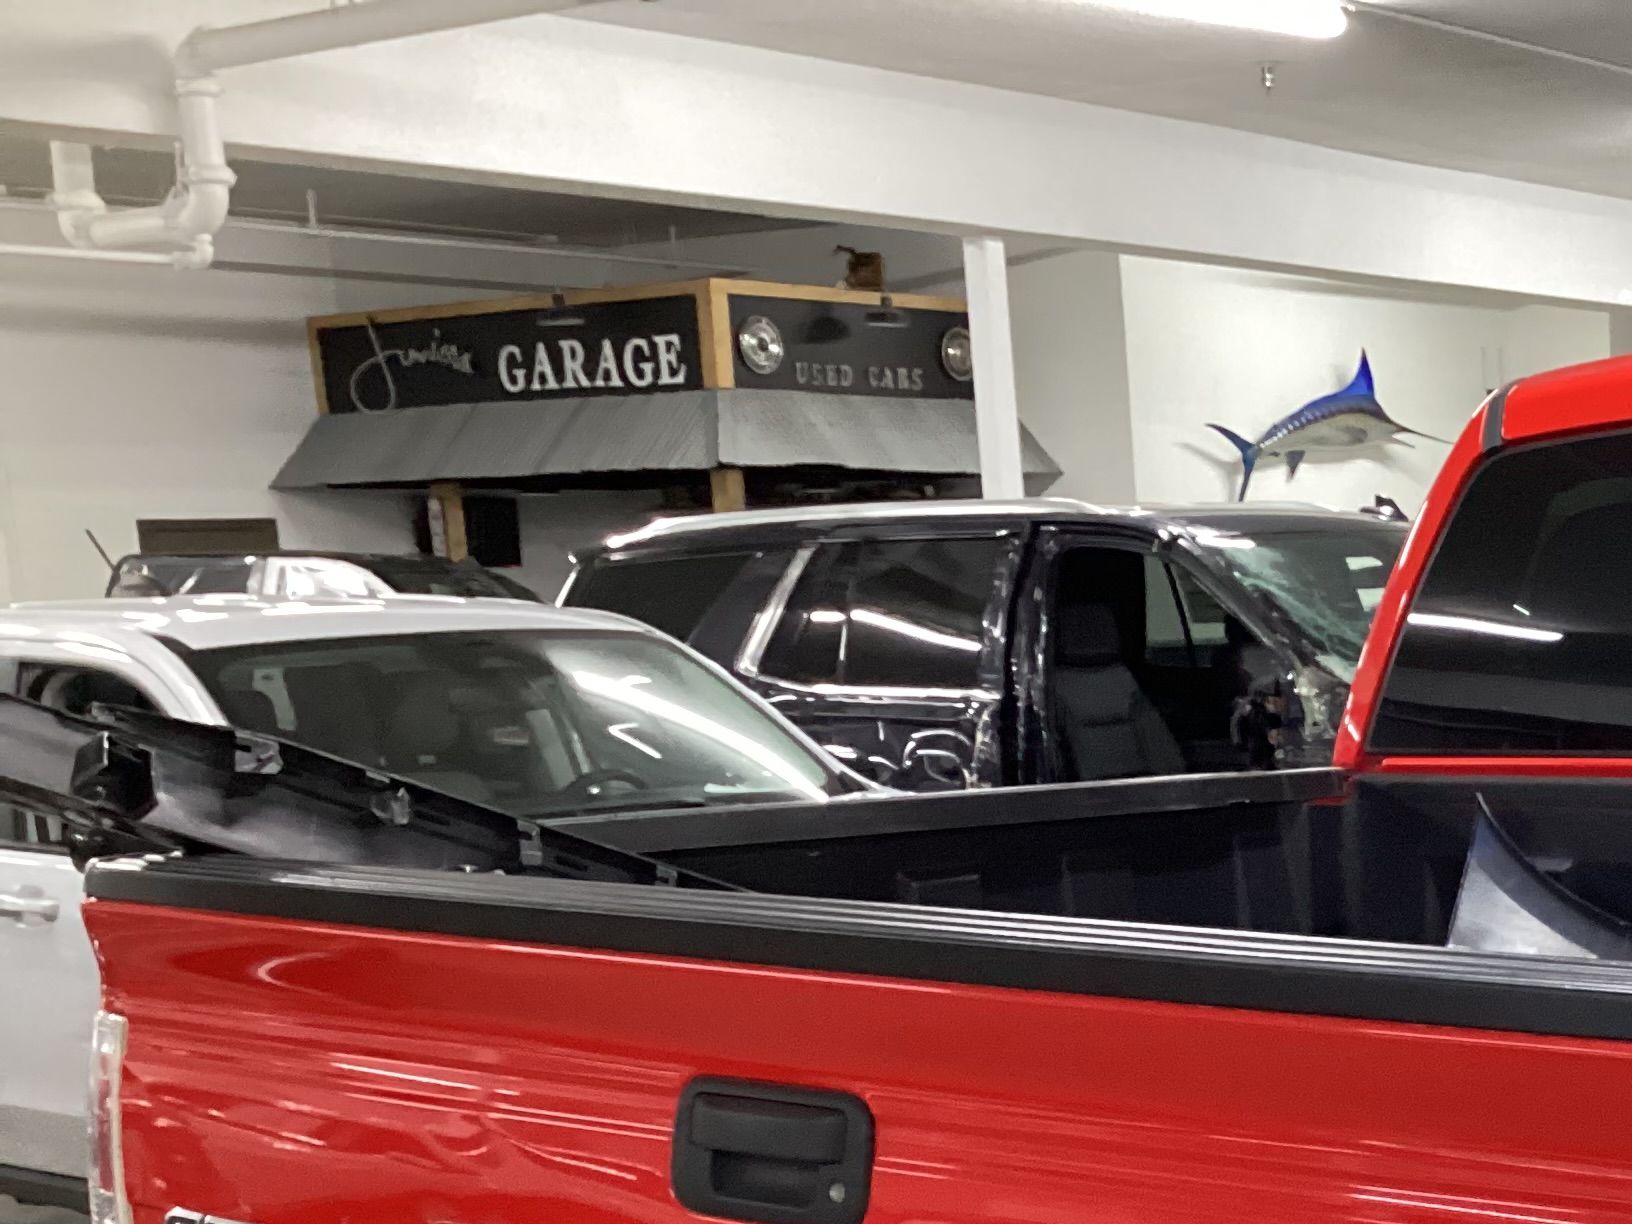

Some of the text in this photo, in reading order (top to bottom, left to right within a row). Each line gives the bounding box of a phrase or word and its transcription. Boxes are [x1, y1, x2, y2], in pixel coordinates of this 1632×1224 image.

[497, 333, 687, 393] GARAGE
[795, 361, 923, 391] USED CARS
